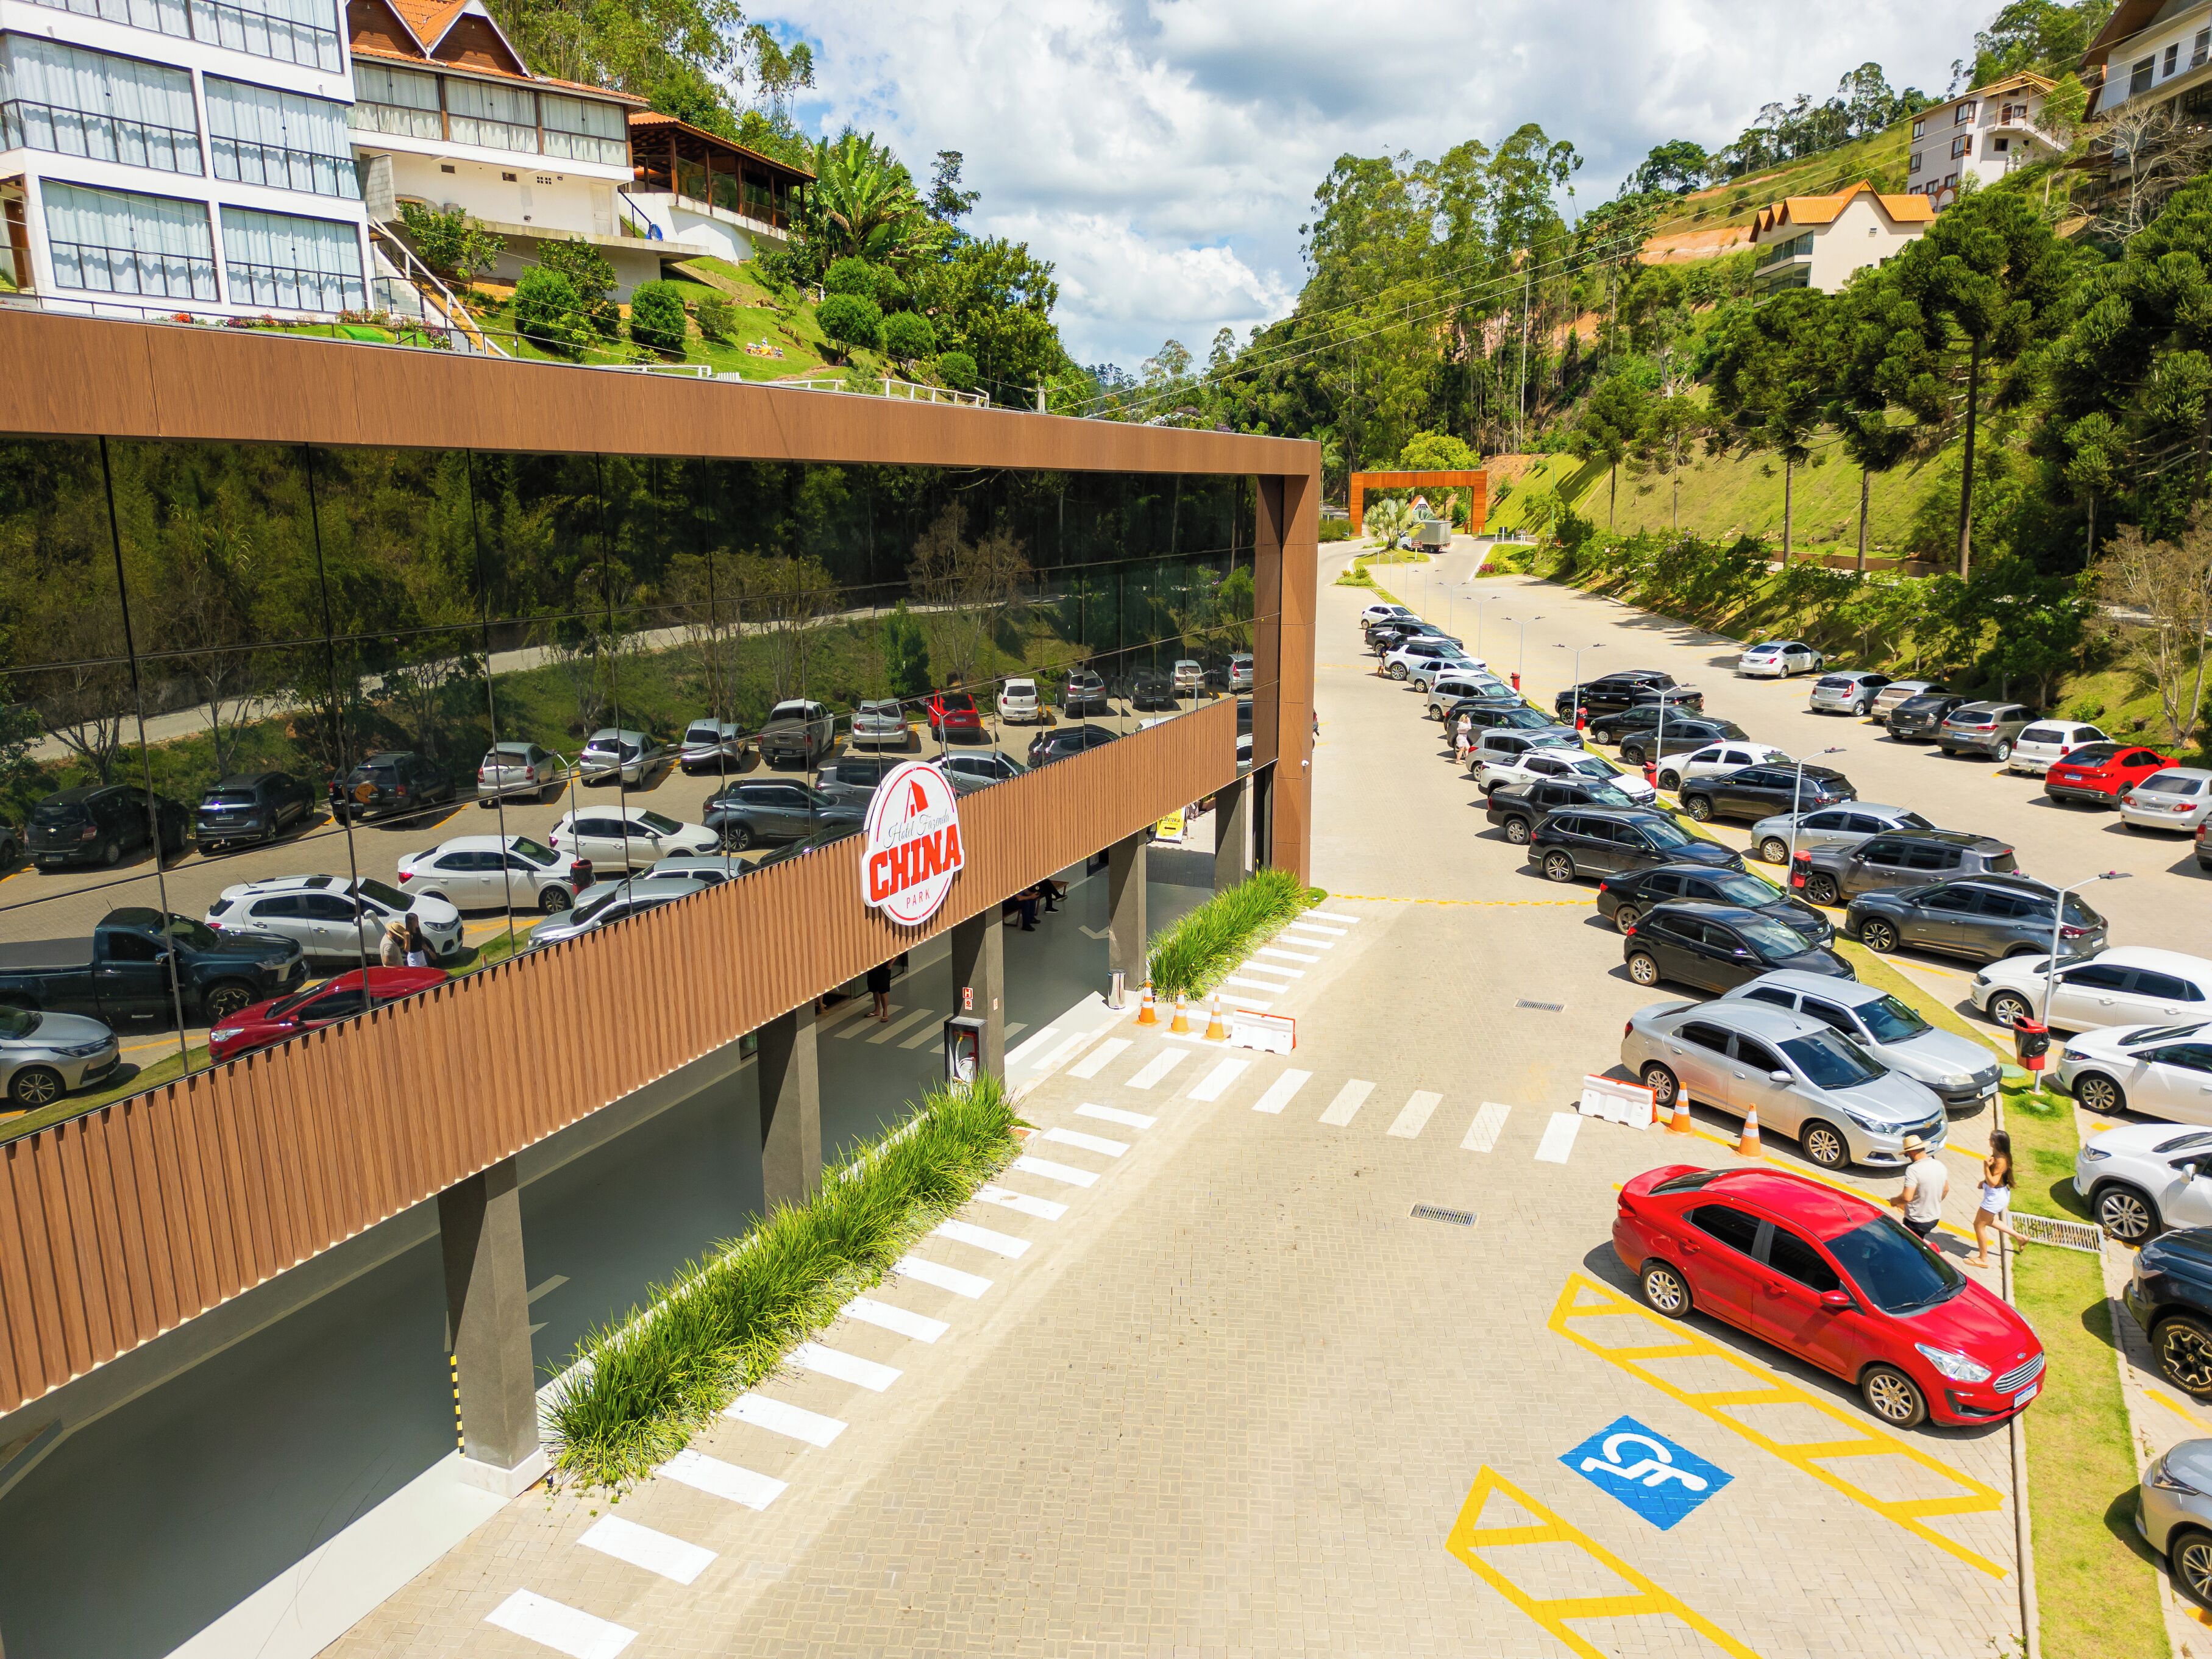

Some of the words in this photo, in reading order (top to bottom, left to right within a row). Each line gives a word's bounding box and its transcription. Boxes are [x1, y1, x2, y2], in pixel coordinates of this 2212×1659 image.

[883, 821, 914, 848] Hotel
[917, 809, 950, 836] Fazenda
[870, 823, 962, 902] CHINA
[906, 888, 930, 909] PARK
